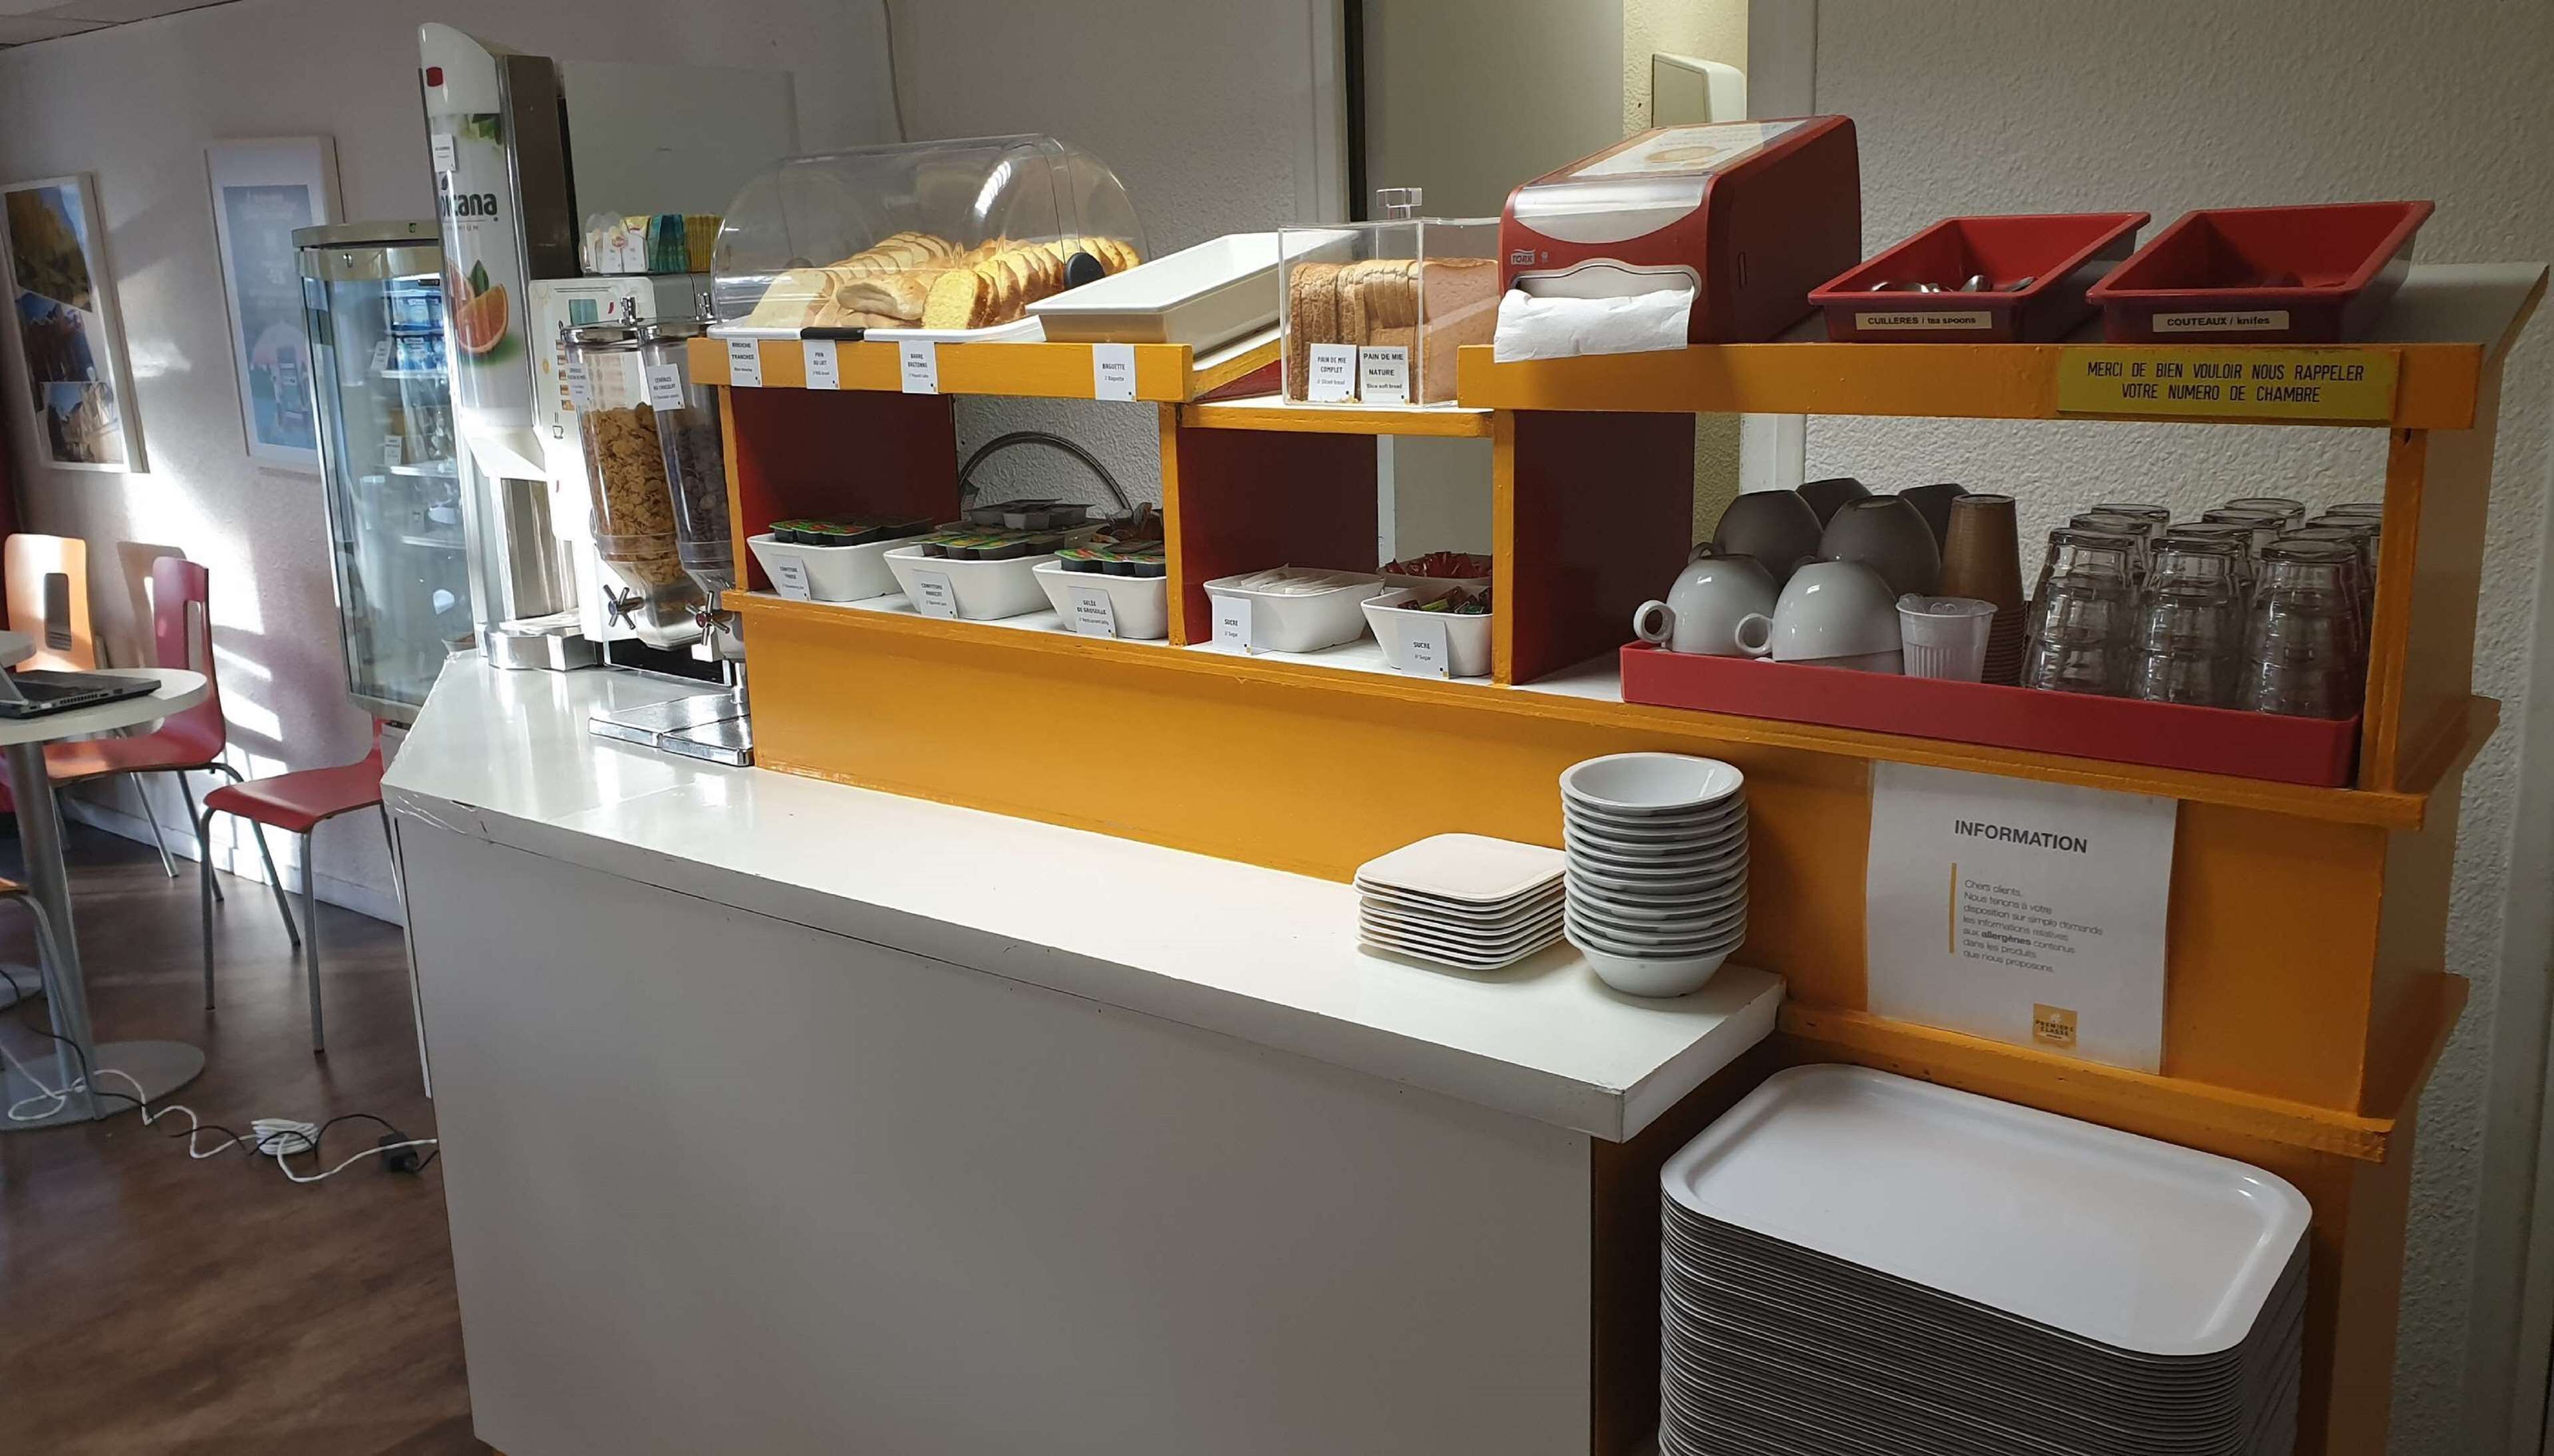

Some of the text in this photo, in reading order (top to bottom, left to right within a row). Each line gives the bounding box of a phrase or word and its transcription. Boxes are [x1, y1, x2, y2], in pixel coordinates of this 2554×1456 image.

[440, 193, 498, 217] icana
[1867, 317, 1919, 325] CUILLERES
[2167, 317, 2227, 326] COUTEAUX
[2088, 361, 2364, 381] MERCI DE BIEN VOULOIR NOUS RAPPELER
[2122, 383, 2320, 402] VOTRE NUMERO DE CHAMBRE
[1955, 819, 2088, 853] INFORMATION
[1965, 879, 1991, 891] Chers
[1964, 892, 1987, 903] Nous
[1989, 896, 2020, 909] tenons
[2030, 905, 2052, 915] votre
[1963, 915, 2069, 942] les informations relatives
[1964, 905, 2010, 918] disposition
[2027, 916, 2058, 927] simple
[2059, 921, 2103, 936] demande
[1963, 939, 1985, 948] dans
[2001, 945, 2036, 958] produits
[1981, 931, 2031, 945] allergènes
[2034, 941, 2076, 954] contenus
[1963, 950, 1981, 958] que
[1982, 954, 2004, 963] nous
